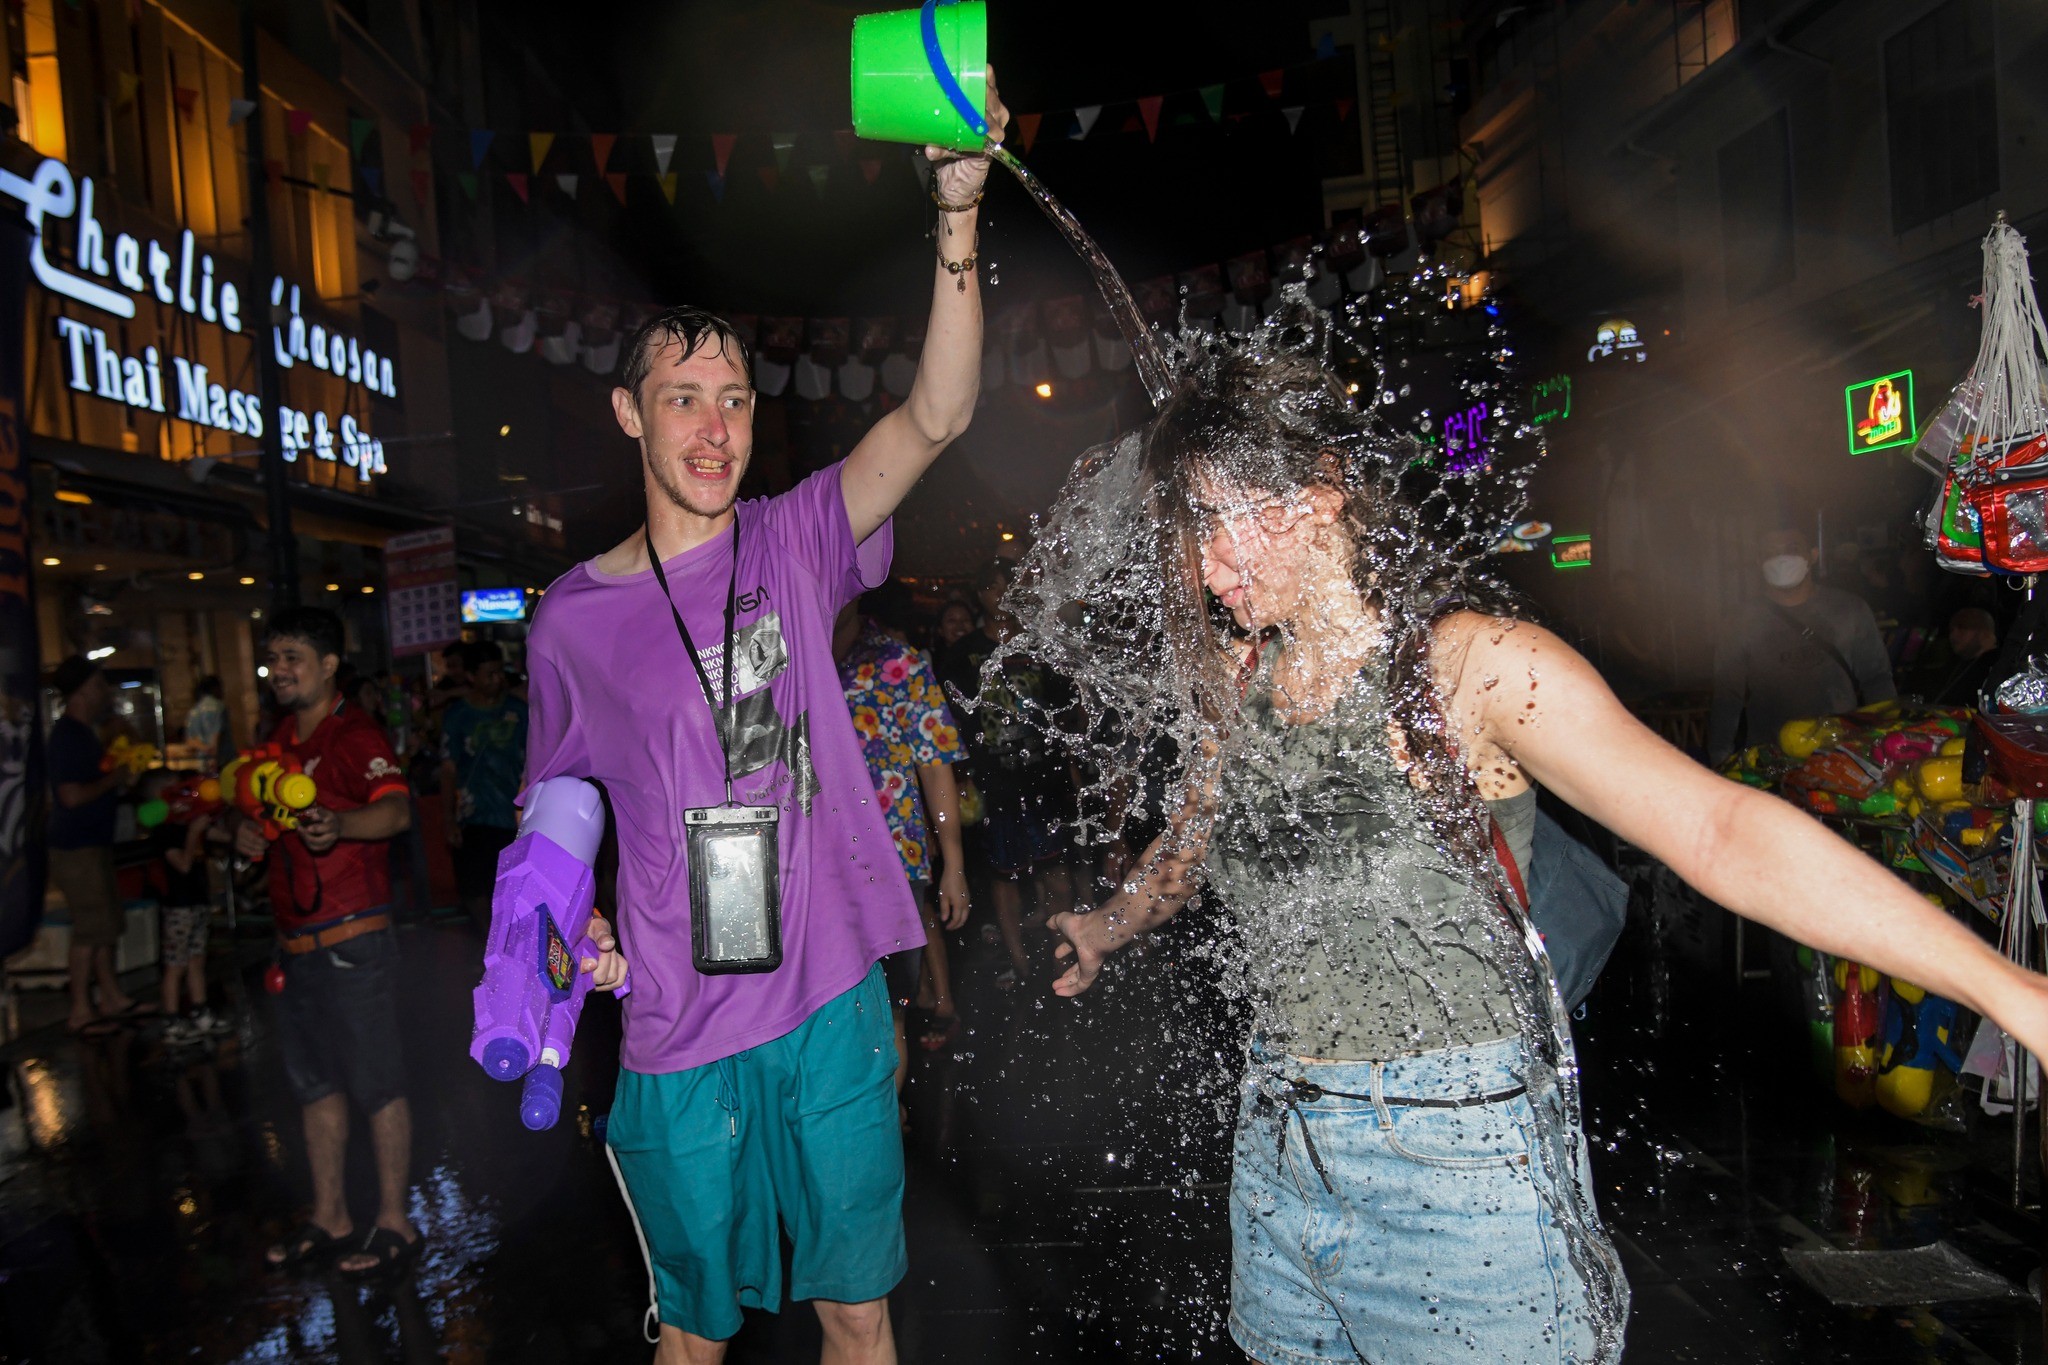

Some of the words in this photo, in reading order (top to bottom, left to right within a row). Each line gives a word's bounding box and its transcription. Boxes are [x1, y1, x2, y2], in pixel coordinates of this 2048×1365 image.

[0, 158, 242, 333] Charlie
[57, 316, 165, 412] Thai
[173, 356, 310, 463] Massge
[313, 410, 337, 462] &
[340, 414, 386, 483] Spa
